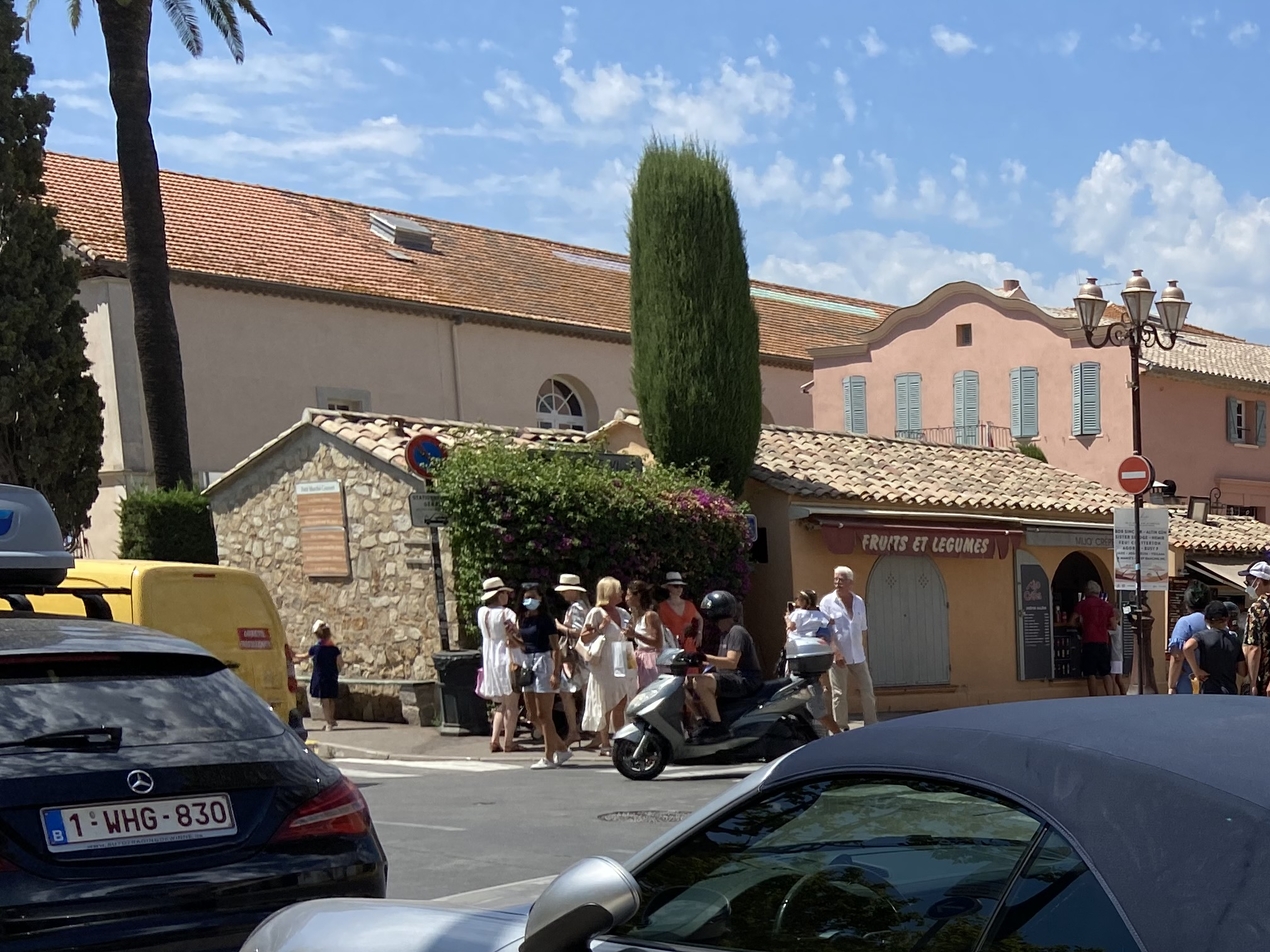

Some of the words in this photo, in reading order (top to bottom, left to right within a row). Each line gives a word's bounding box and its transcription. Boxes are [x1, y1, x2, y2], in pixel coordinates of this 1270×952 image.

[862, 533, 908, 551] FRUITS
[912, 536, 929, 552] ET
[932, 537, 989, 553] LEGUMES
[52, 829, 64, 842] B
